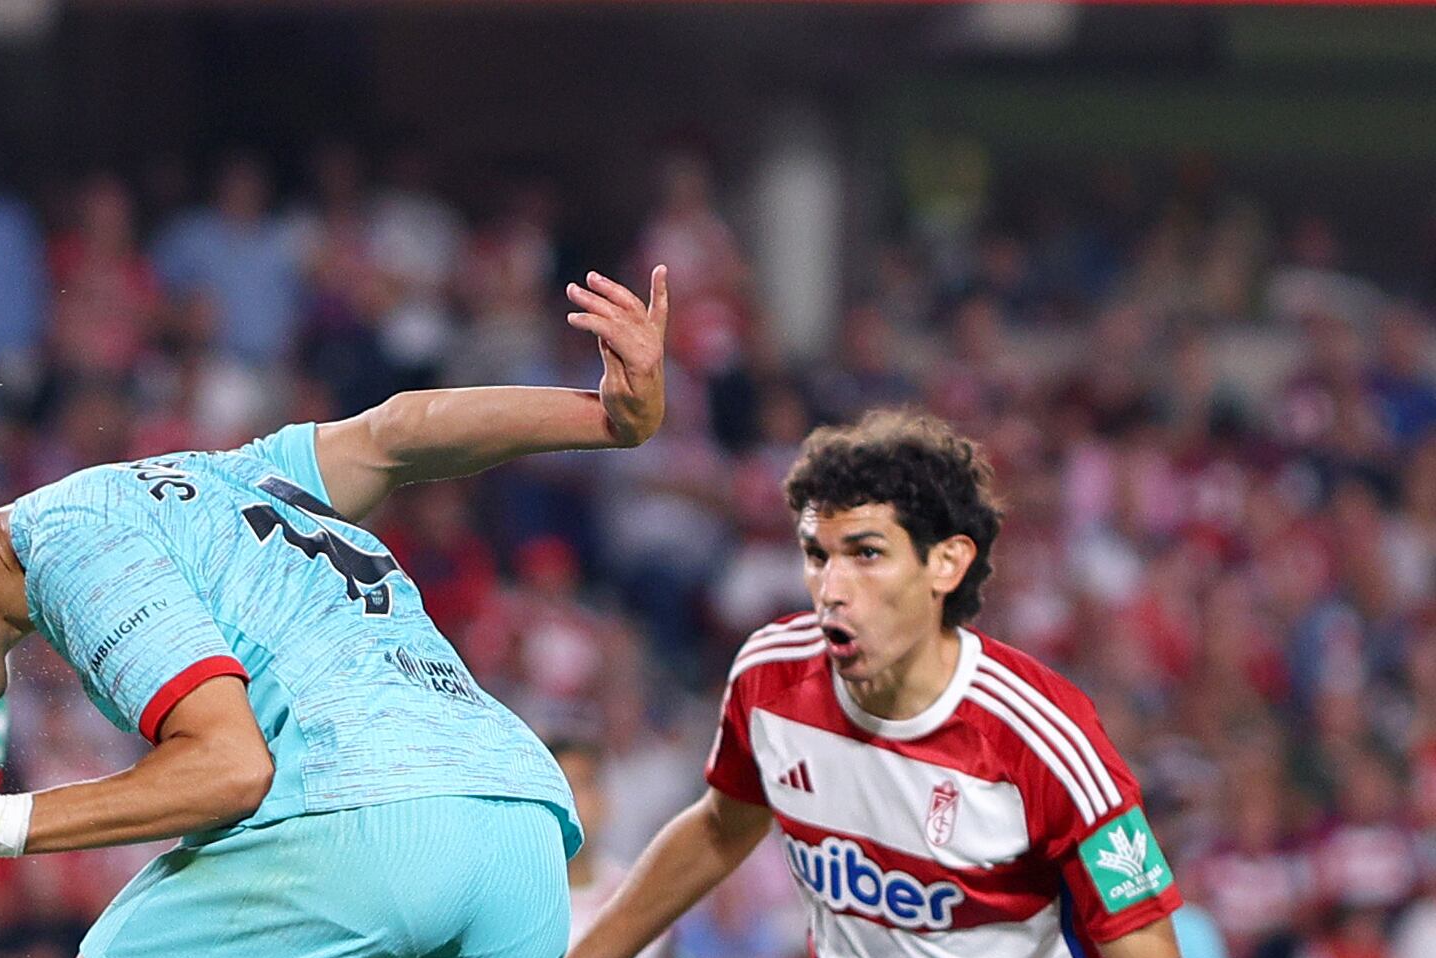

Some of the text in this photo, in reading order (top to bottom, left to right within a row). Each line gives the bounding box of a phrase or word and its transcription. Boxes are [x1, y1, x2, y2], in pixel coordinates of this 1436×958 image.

[241, 475, 400, 615] 14
[90, 604, 151, 674] MBILIGHT
[418, 658, 468, 684] UNH
[787, 840, 958, 922] wiber
